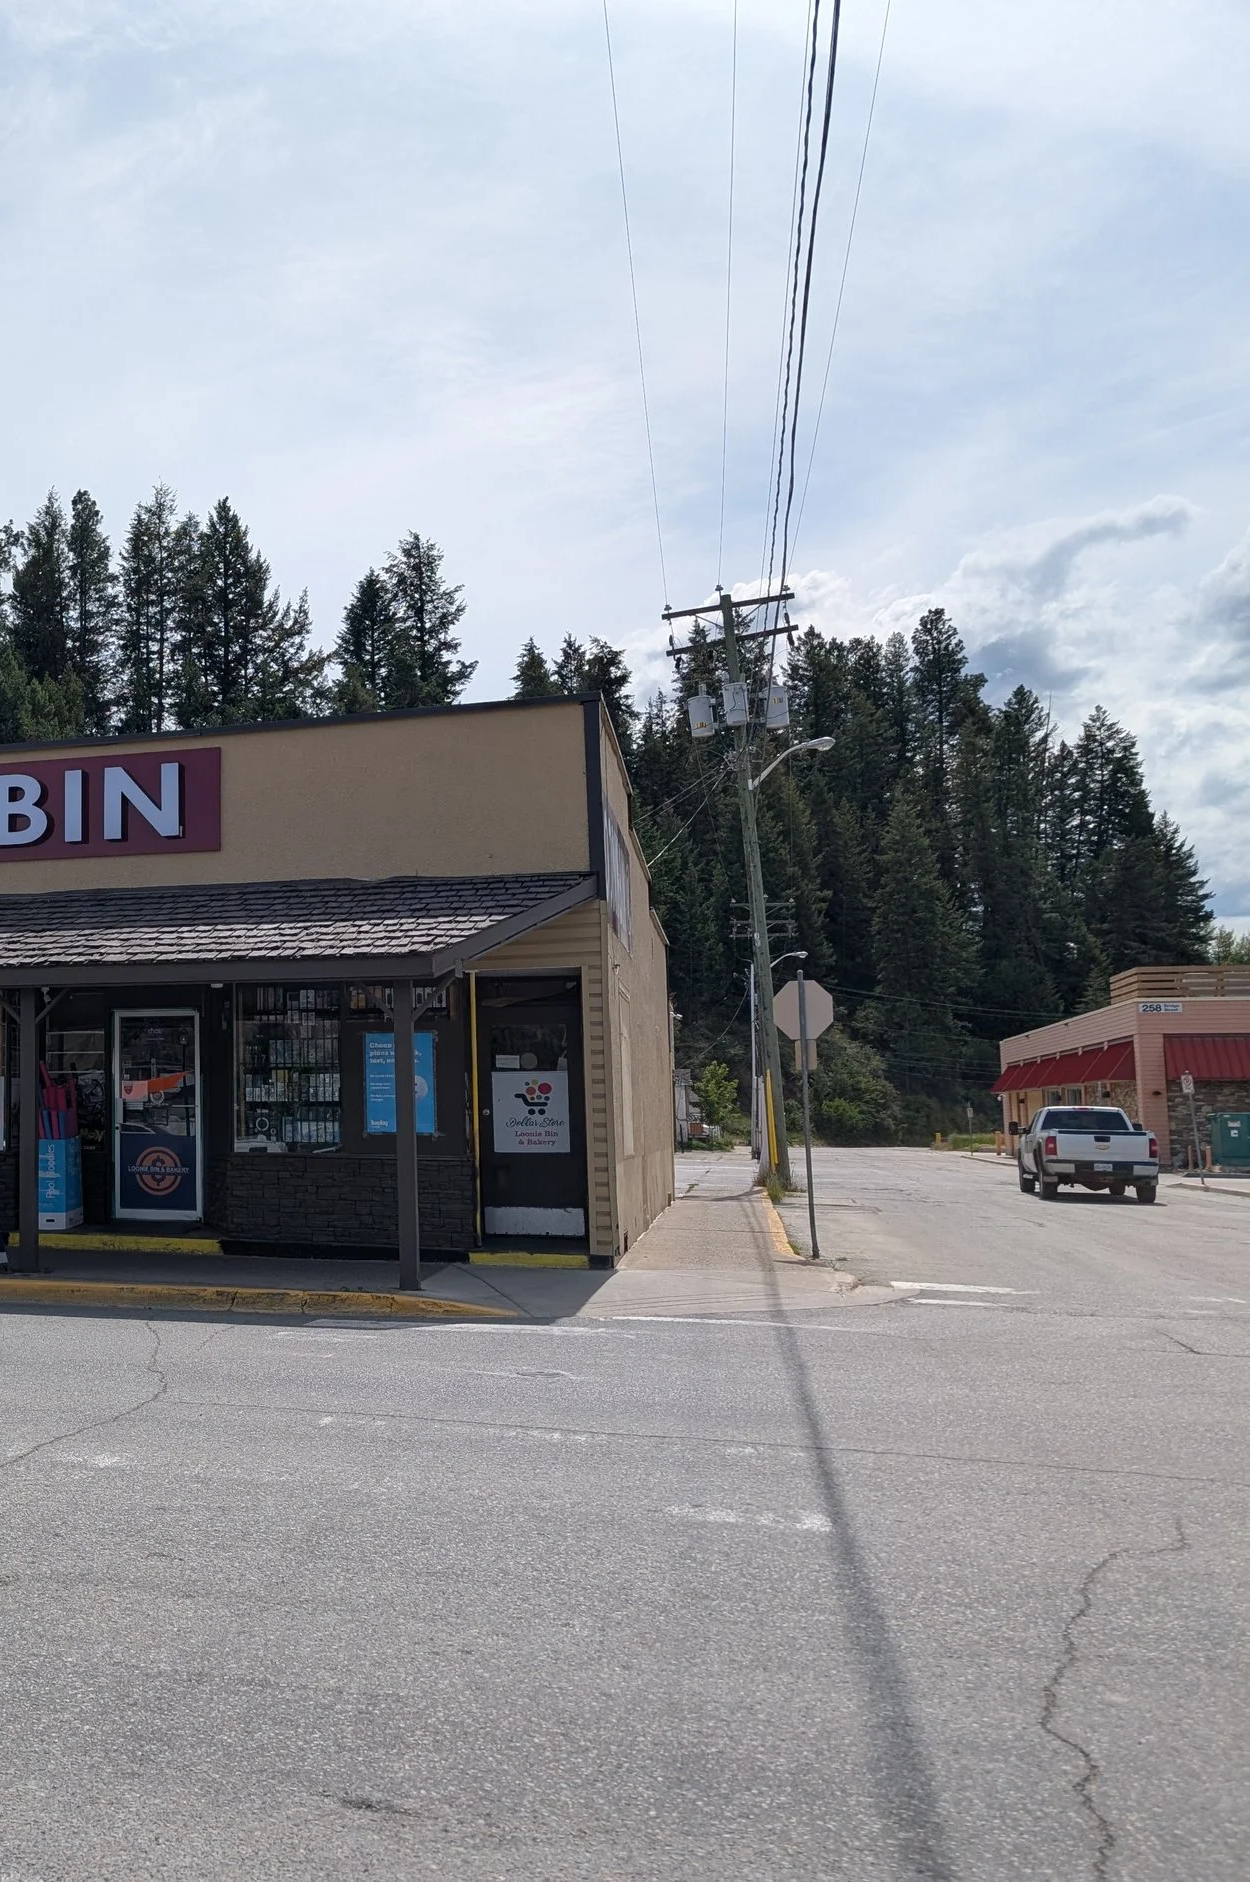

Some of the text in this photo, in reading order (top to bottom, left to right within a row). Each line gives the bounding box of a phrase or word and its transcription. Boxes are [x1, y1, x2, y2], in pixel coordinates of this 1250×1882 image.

[1142, 1004, 1162, 1012] 258
[369, 1042, 392, 1050] Cheap
[505, 1115, 565, 1128] Dollar Store
[526, 1138, 557, 1147] Bakery
